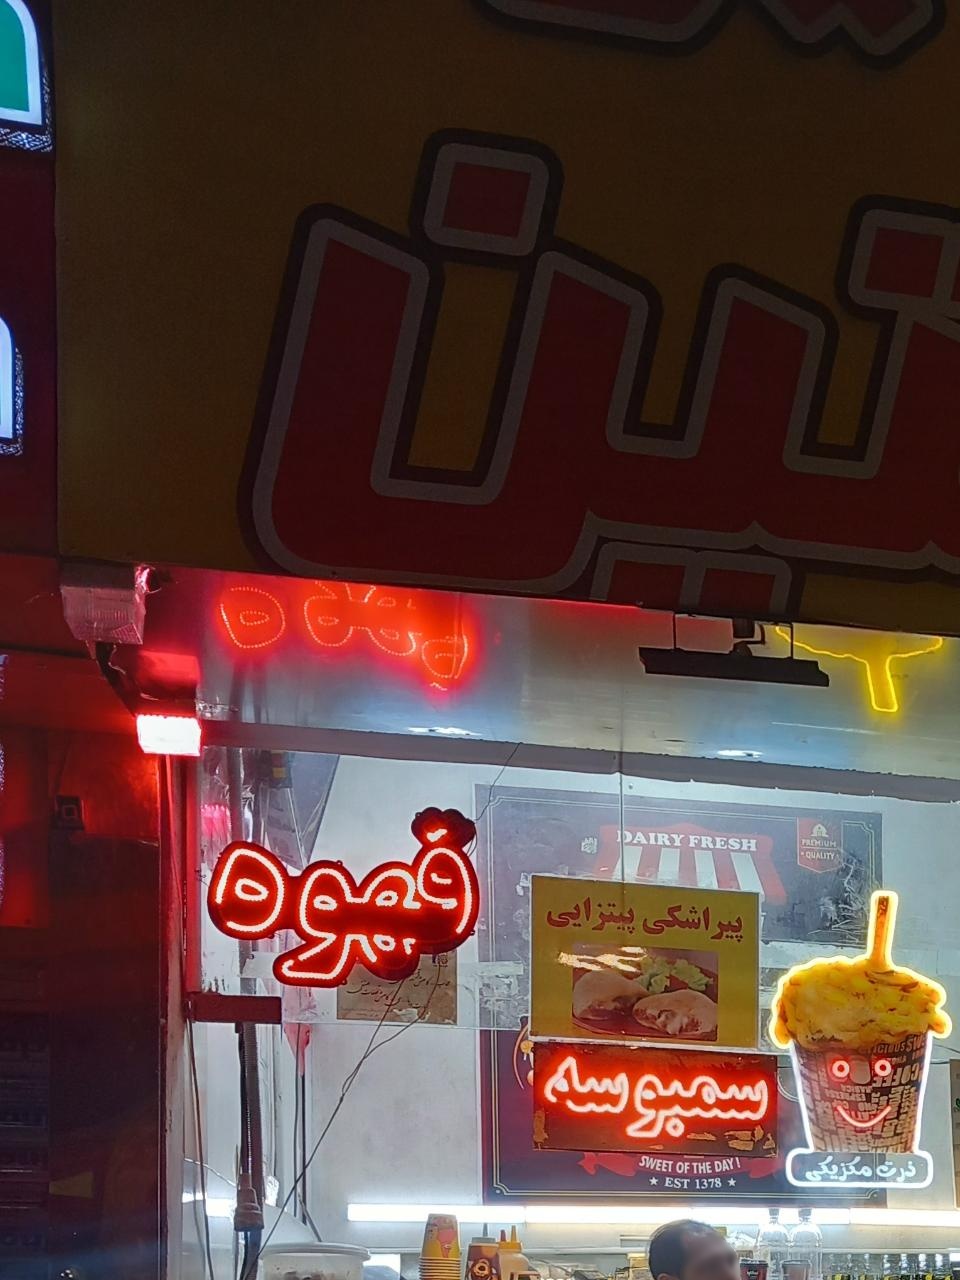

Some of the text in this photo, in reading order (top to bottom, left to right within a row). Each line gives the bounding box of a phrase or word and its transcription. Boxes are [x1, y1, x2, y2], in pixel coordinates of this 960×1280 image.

[616, 830, 685, 847] DAIRY
[689, 835, 757, 851] FRESH
[801, 839, 837, 848] PREMIUM
[806, 851, 835, 860] QUALITY
[546, 896, 743, 942] پیراشکی پیتزایی
[543, 1055, 769, 1138] سمبوسه
[638, 1155, 674, 1172] SWEET
[675, 1161, 690, 1174] OF
[692, 1162, 712, 1174] THE
[805, 1156, 917, 1182] ذرت مکزیکی
[664, 1177, 722, 1189] EST 1378
